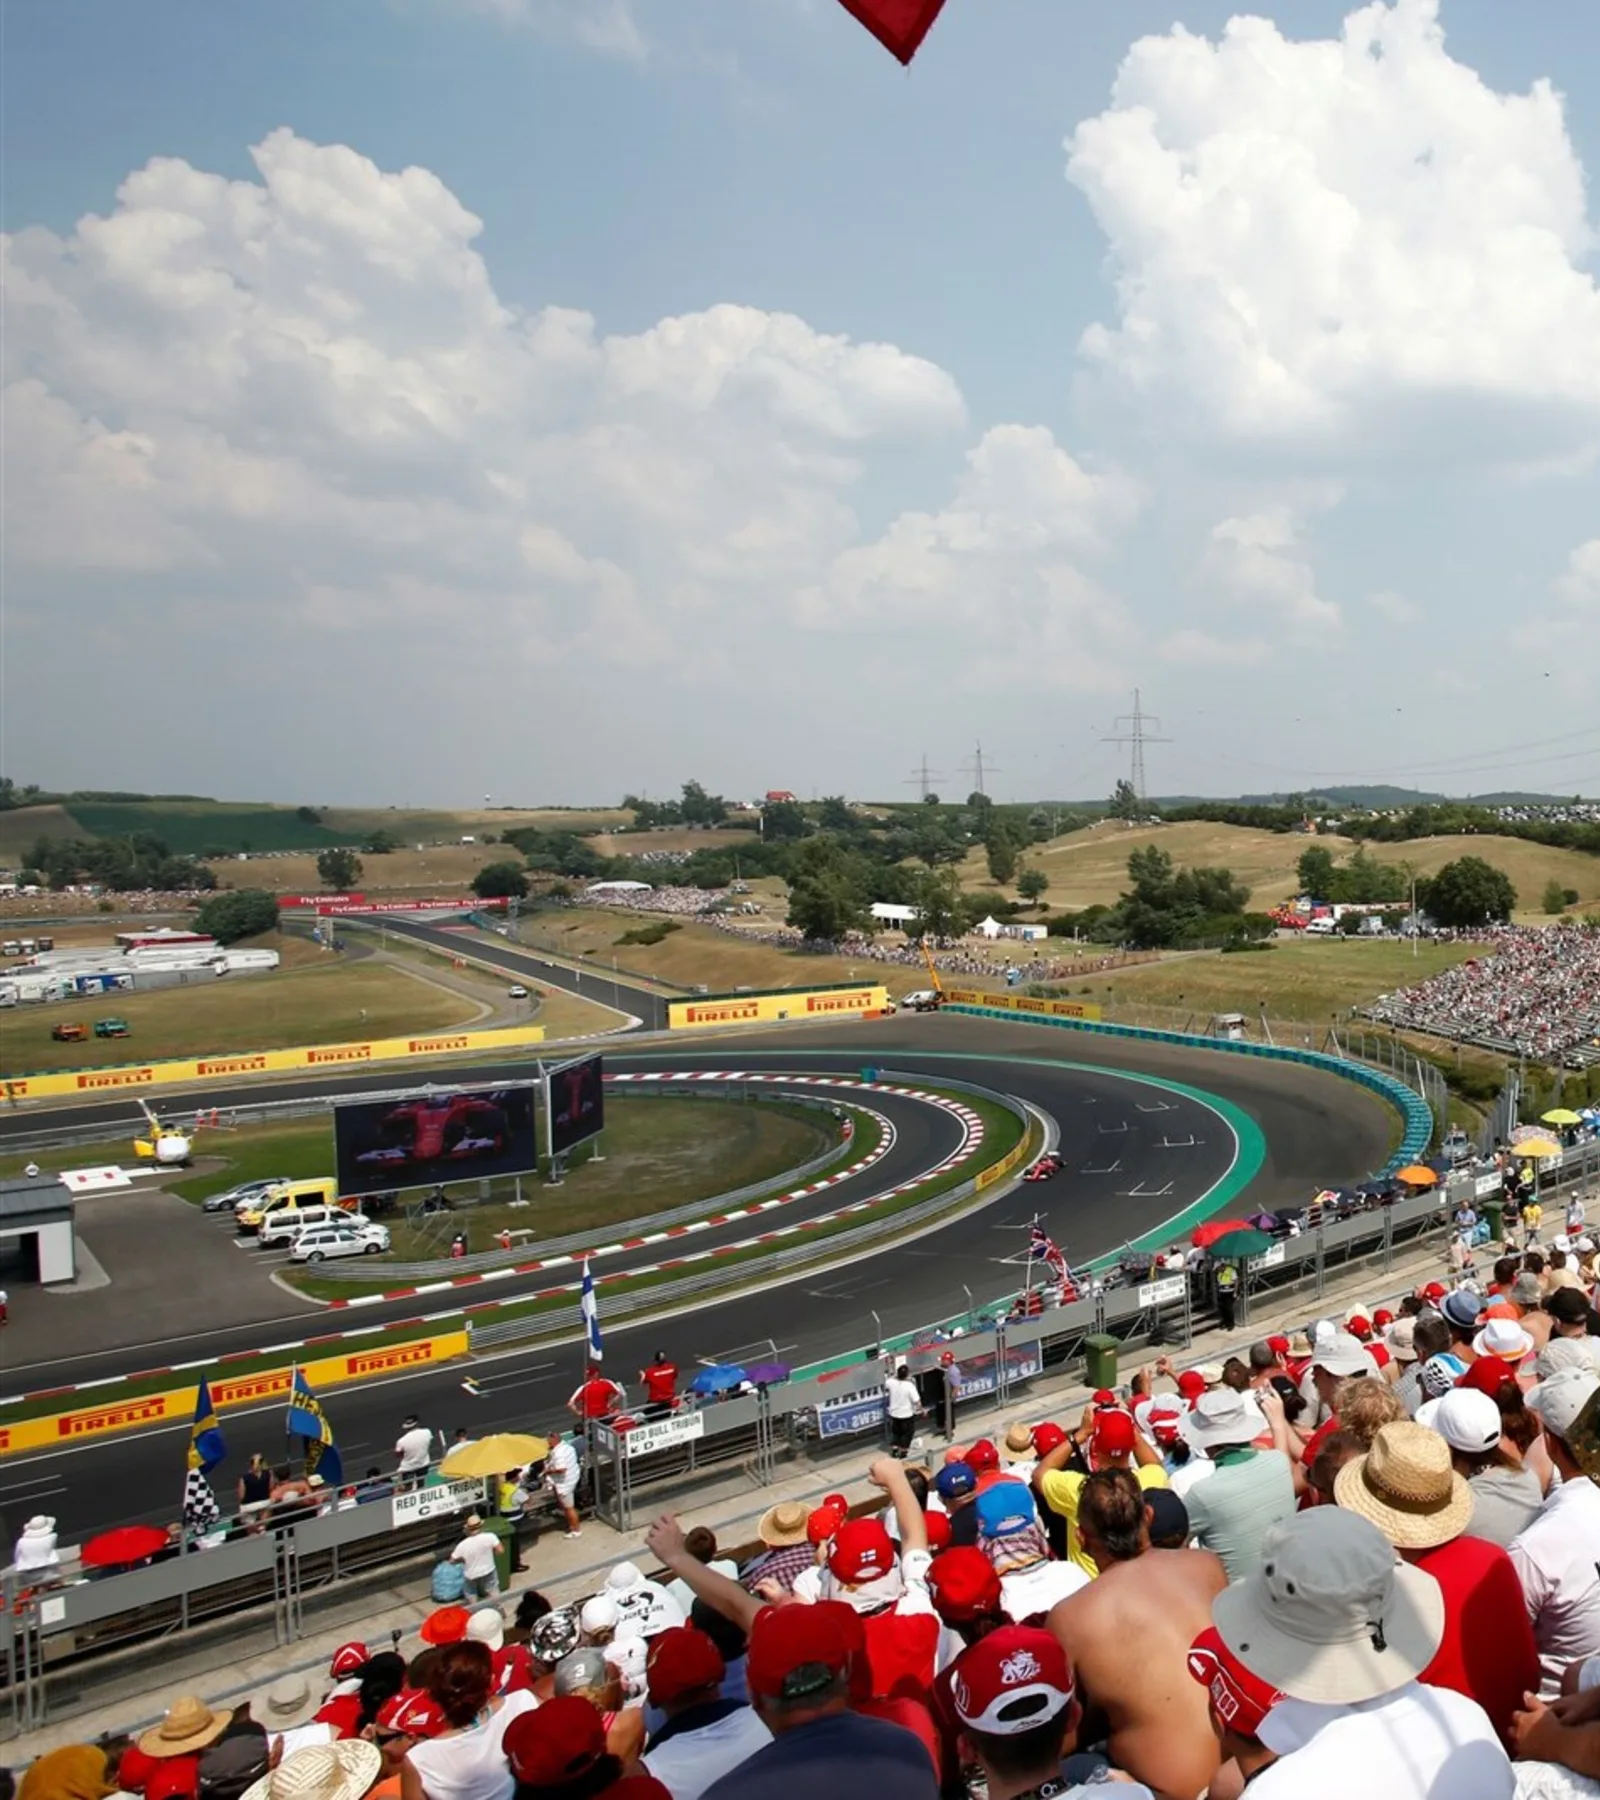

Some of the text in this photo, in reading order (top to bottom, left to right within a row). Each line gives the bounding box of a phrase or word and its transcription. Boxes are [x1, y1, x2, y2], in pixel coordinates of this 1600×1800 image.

[807, 993, 872, 1011] PIRELLI
[687, 1002, 758, 1022] PIRELLI
[409, 1036, 468, 1052] PIRELLI
[307, 1046, 371, 1063] PIRELLI
[197, 1056, 266, 1075] PIRELLI
[78, 1069, 152, 1088] PIRELLI
[347, 1342, 431, 1374] PIRELLI
[58, 1397, 165, 1436] PIRELLI
[629, 1429, 647, 1442] RED
[648, 1423, 669, 1438] BULL
[643, 1441, 654, 1451] D
[396, 1495, 417, 1511] RED
[419, 1488, 445, 1505] BULL
[418, 1506, 430, 1516] C
